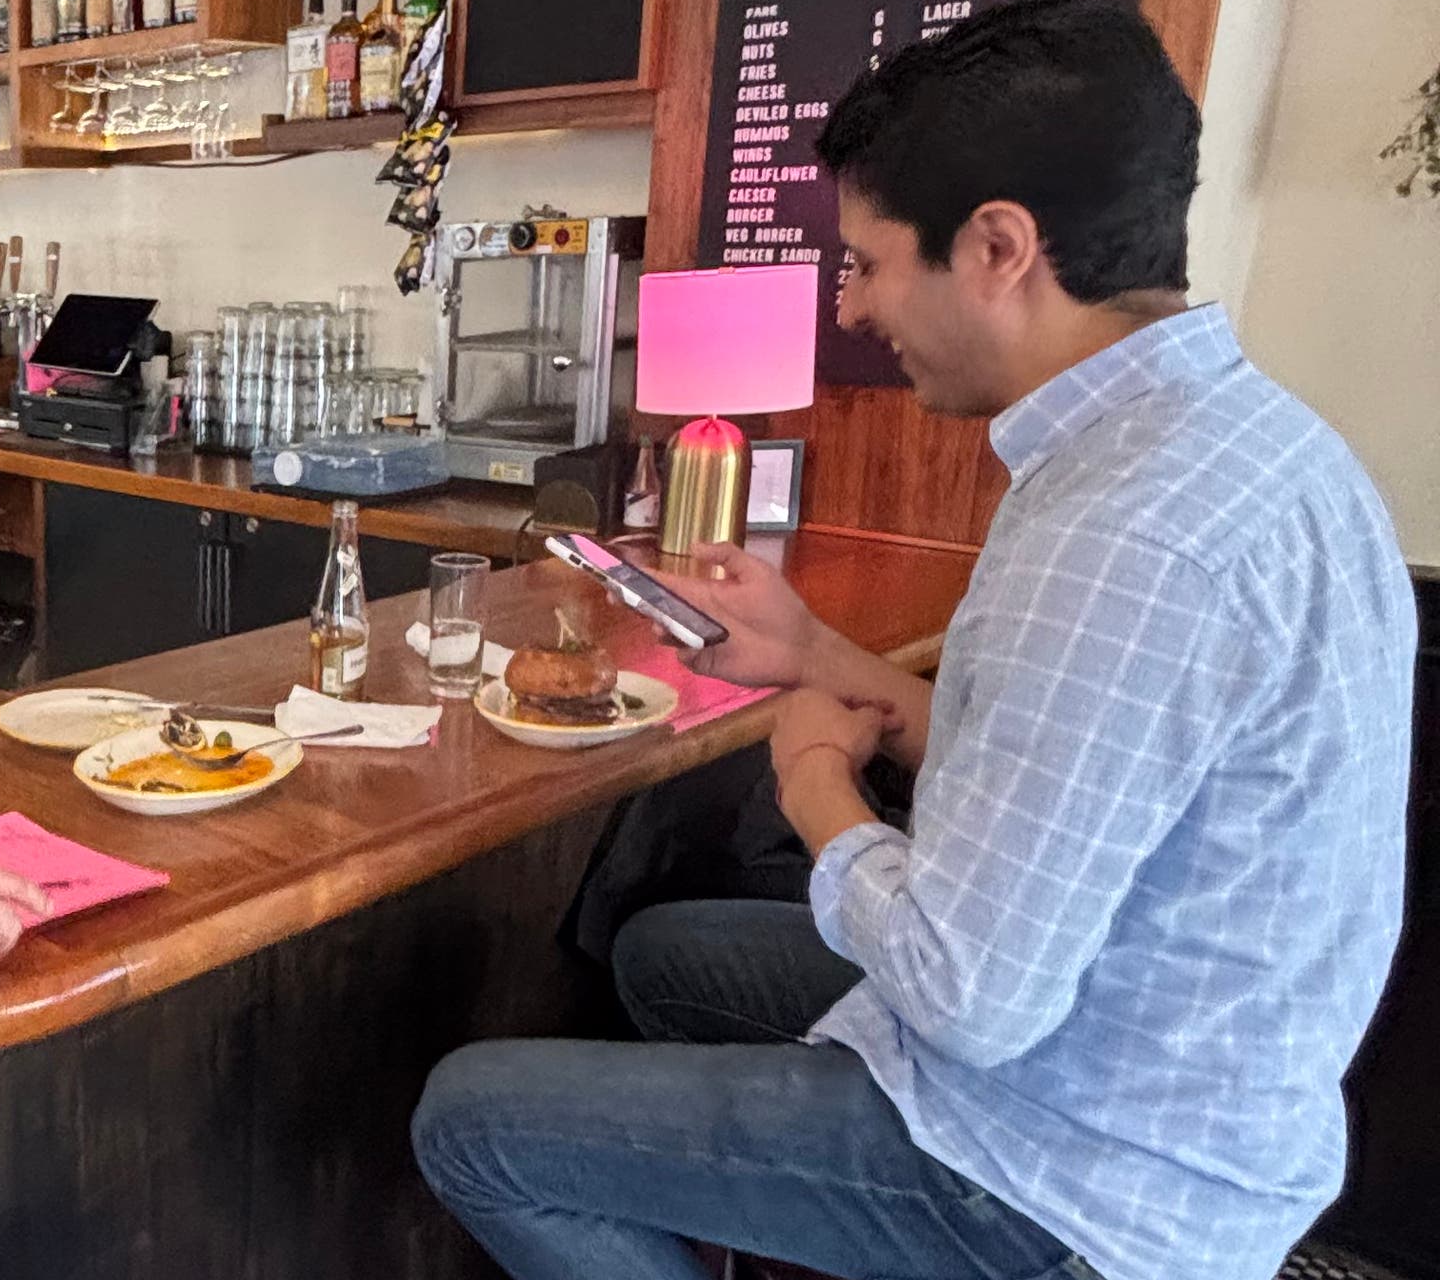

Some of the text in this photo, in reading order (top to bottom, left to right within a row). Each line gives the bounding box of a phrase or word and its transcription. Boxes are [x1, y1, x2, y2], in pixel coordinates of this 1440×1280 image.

[745, 4, 778, 19] FARE
[922, 1, 972, 22] LAGER
[743, 9, 885, 40] OLIVES 6
[741, 43, 775, 61] NUTS
[739, 64, 777, 82] FRIES
[737, 84, 786, 102] CHEESE
[735, 102, 829, 122] DEVILED EGGS
[734, 126, 790, 143] HUMMUS
[732, 147, 772, 163] WINGS
[730, 166, 818, 183] CAULIFLOWER
[728, 187, 776, 203] CAESER
[726, 208, 774, 223] BURGER
[725, 228, 803, 243] VEG BURGER
[723, 248, 775, 263] CHICKEN
[780, 248, 821, 263] SANDO
